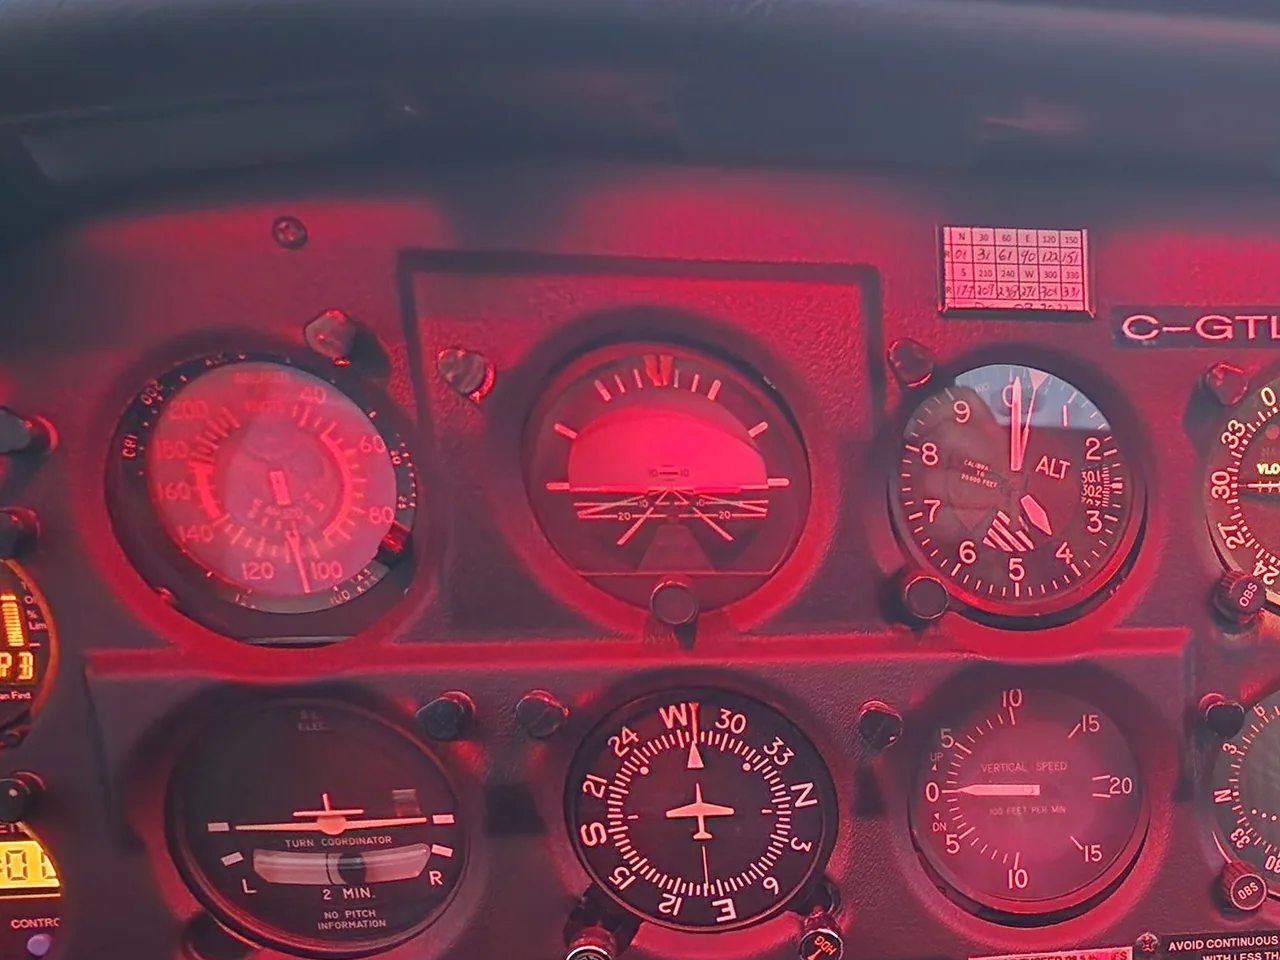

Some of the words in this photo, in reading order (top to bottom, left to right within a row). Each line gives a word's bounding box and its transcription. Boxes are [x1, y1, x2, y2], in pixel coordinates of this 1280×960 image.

[979, 233, 989, 242] 30
[1220, 419, 1245, 450] 33
[1035, 455, 1071, 480] ALT
[1211, 471, 1231, 499] 30
[1253, 561, 1280, 586] 24
[1002, 688, 1022, 707] 10
[714, 708, 747, 734] 30
[1081, 715, 1100, 732] 15
[607, 726, 640, 757] 24
[763, 736, 795, 766] 33
[981, 762, 1027, 773] VERTICAL
[1035, 761, 1067, 772] SPEED
[582, 774, 607, 798] 21
[790, 782, 818, 808] N
[1109, 777, 1132, 795] 20
[285, 839, 314, 848] TURN
[321, 835, 393, 847] COORDINATOR
[580, 821, 607, 846] S
[1084, 844, 1102, 862] 15
[608, 866, 636, 891] 15
[1008, 869, 1028, 889] 10
[324, 911, 339, 919] NO
[345, 909, 376, 919] PITCH
[658, 893, 682, 916] 12
[712, 898, 737, 923] E
[317, 920, 386, 930] INFORMATION
[1168, 939, 1204, 952] AVOID
[1206, 934, 1279, 950] CONTINUOUS
